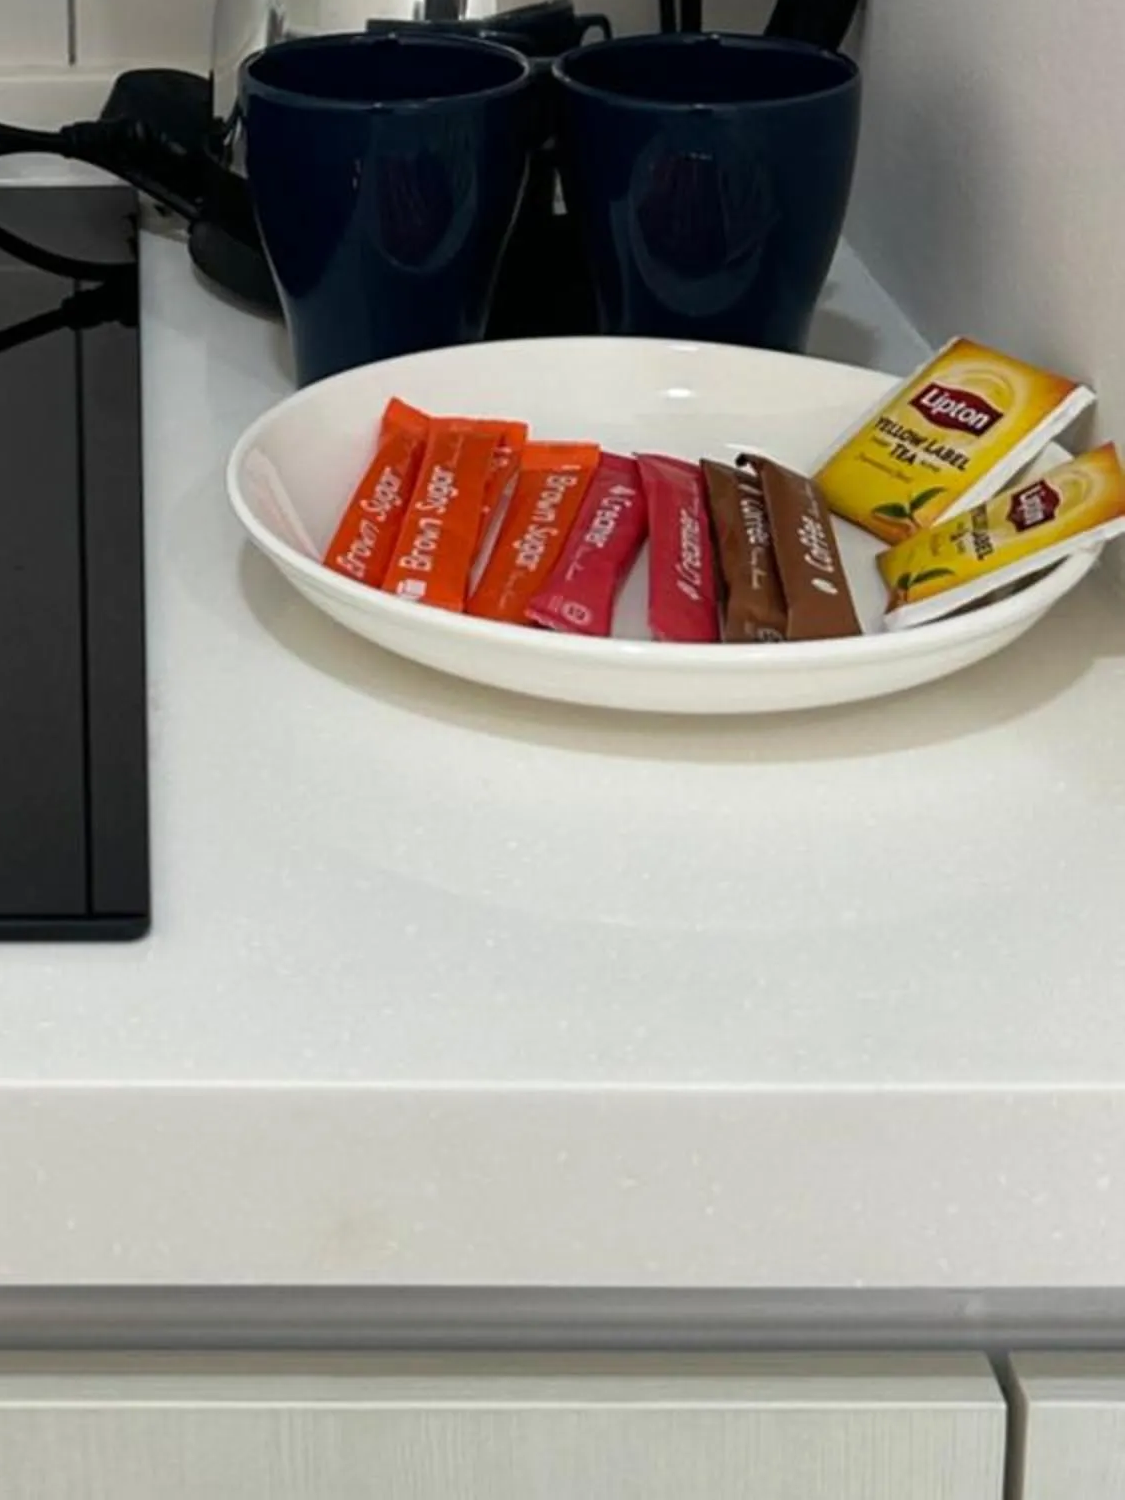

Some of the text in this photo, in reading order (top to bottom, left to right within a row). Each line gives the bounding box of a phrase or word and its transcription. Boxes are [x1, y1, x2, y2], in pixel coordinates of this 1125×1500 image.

[920, 388, 990, 430] Lipton
[875, 416, 928, 447] YELLOW
[923, 438, 970, 472] LABEL
[889, 442, 917, 466] TEA
[360, 466, 402, 522] Sugar
[415, 465, 459, 514] Sugar
[534, 473, 578, 523] Brown
[398, 518, 443, 571] Brown
[512, 526, 559, 573] Sugar
[796, 514, 835, 573] Coffee
